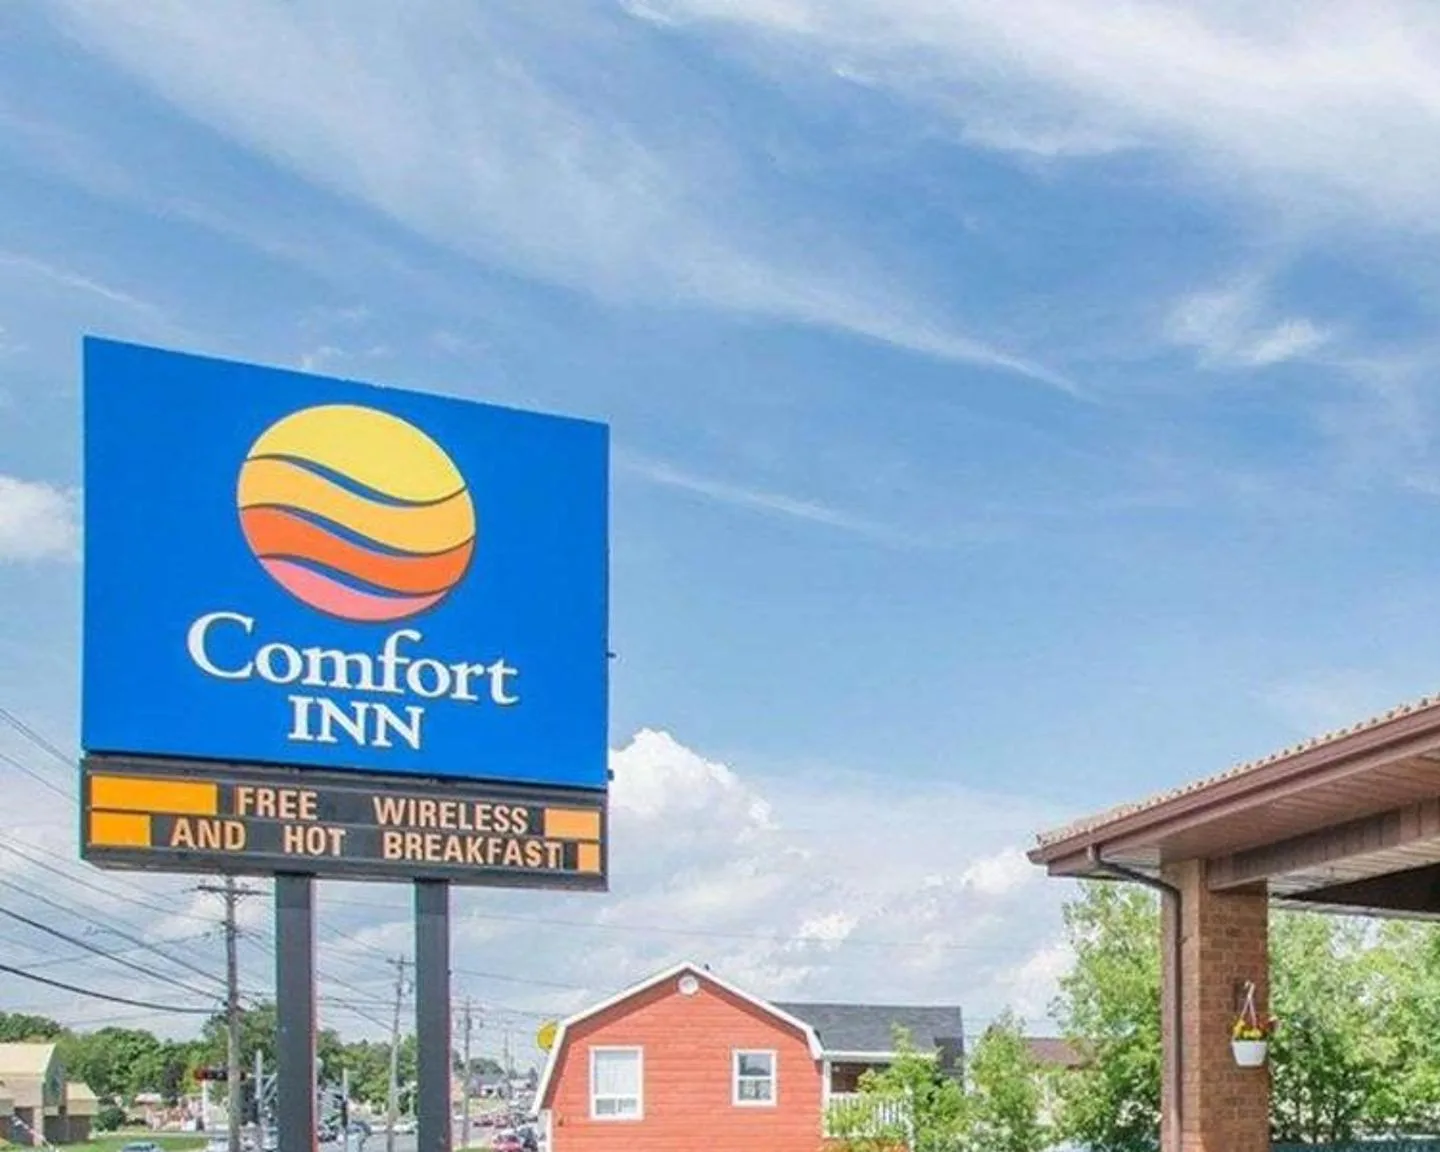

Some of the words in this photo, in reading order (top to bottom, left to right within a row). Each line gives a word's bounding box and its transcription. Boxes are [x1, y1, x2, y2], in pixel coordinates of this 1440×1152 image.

[187, 611, 519, 705] Comfort
[287, 696, 425, 751] INN
[235, 787, 318, 820] FREE
[373, 797, 528, 832] WIRELESS
[170, 819, 246, 850] AND
[283, 827, 346, 857] HOT
[383, 831, 564, 868] BREAKFAST
